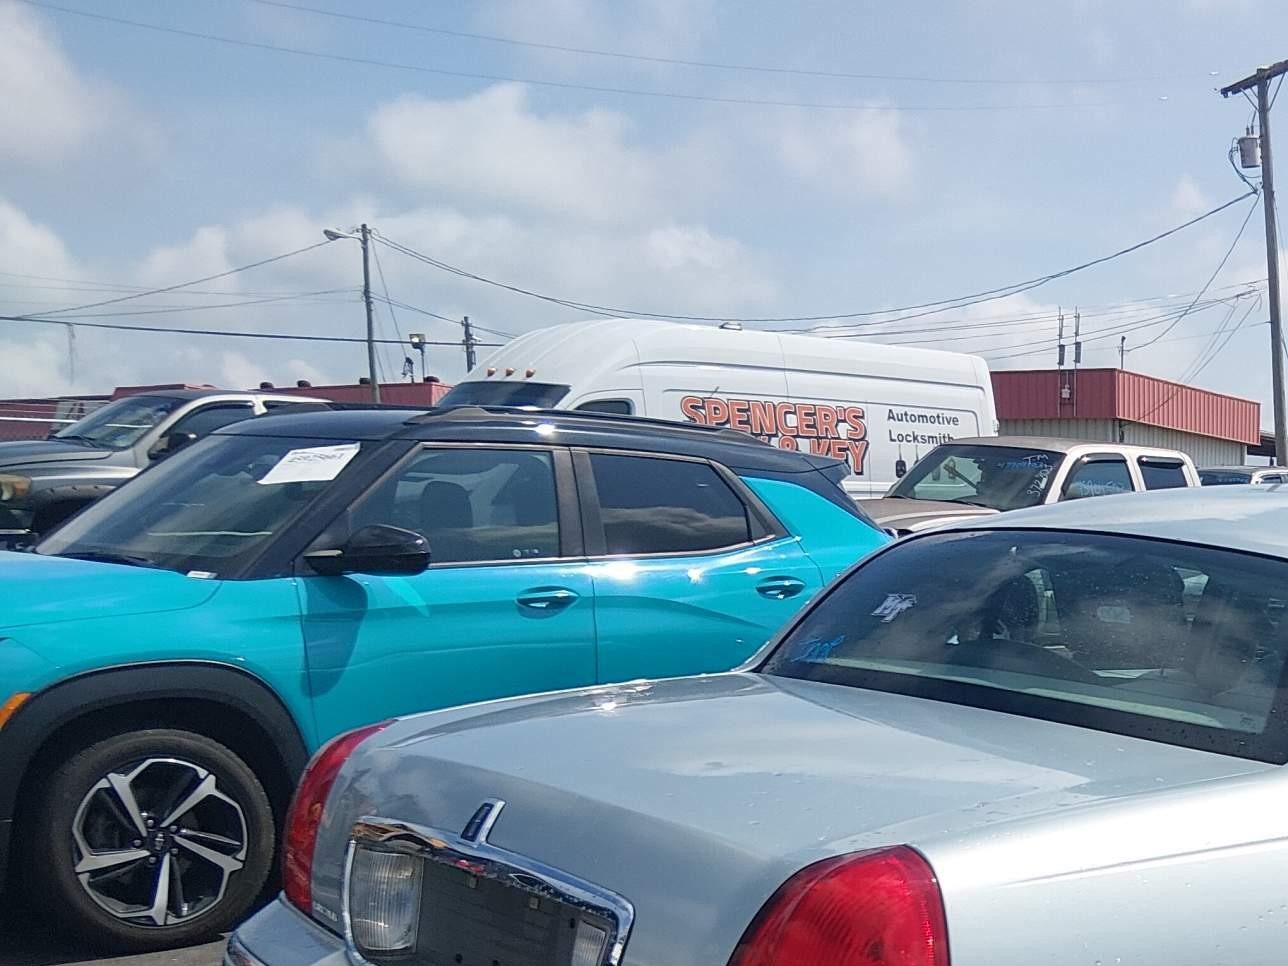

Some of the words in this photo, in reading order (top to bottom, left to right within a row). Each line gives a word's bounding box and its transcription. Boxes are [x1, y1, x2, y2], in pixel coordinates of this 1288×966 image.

[681, 396, 867, 441] SPENCER'S
[887, 409, 959, 426] Automotive
[889, 429, 954, 446] Locksmith
